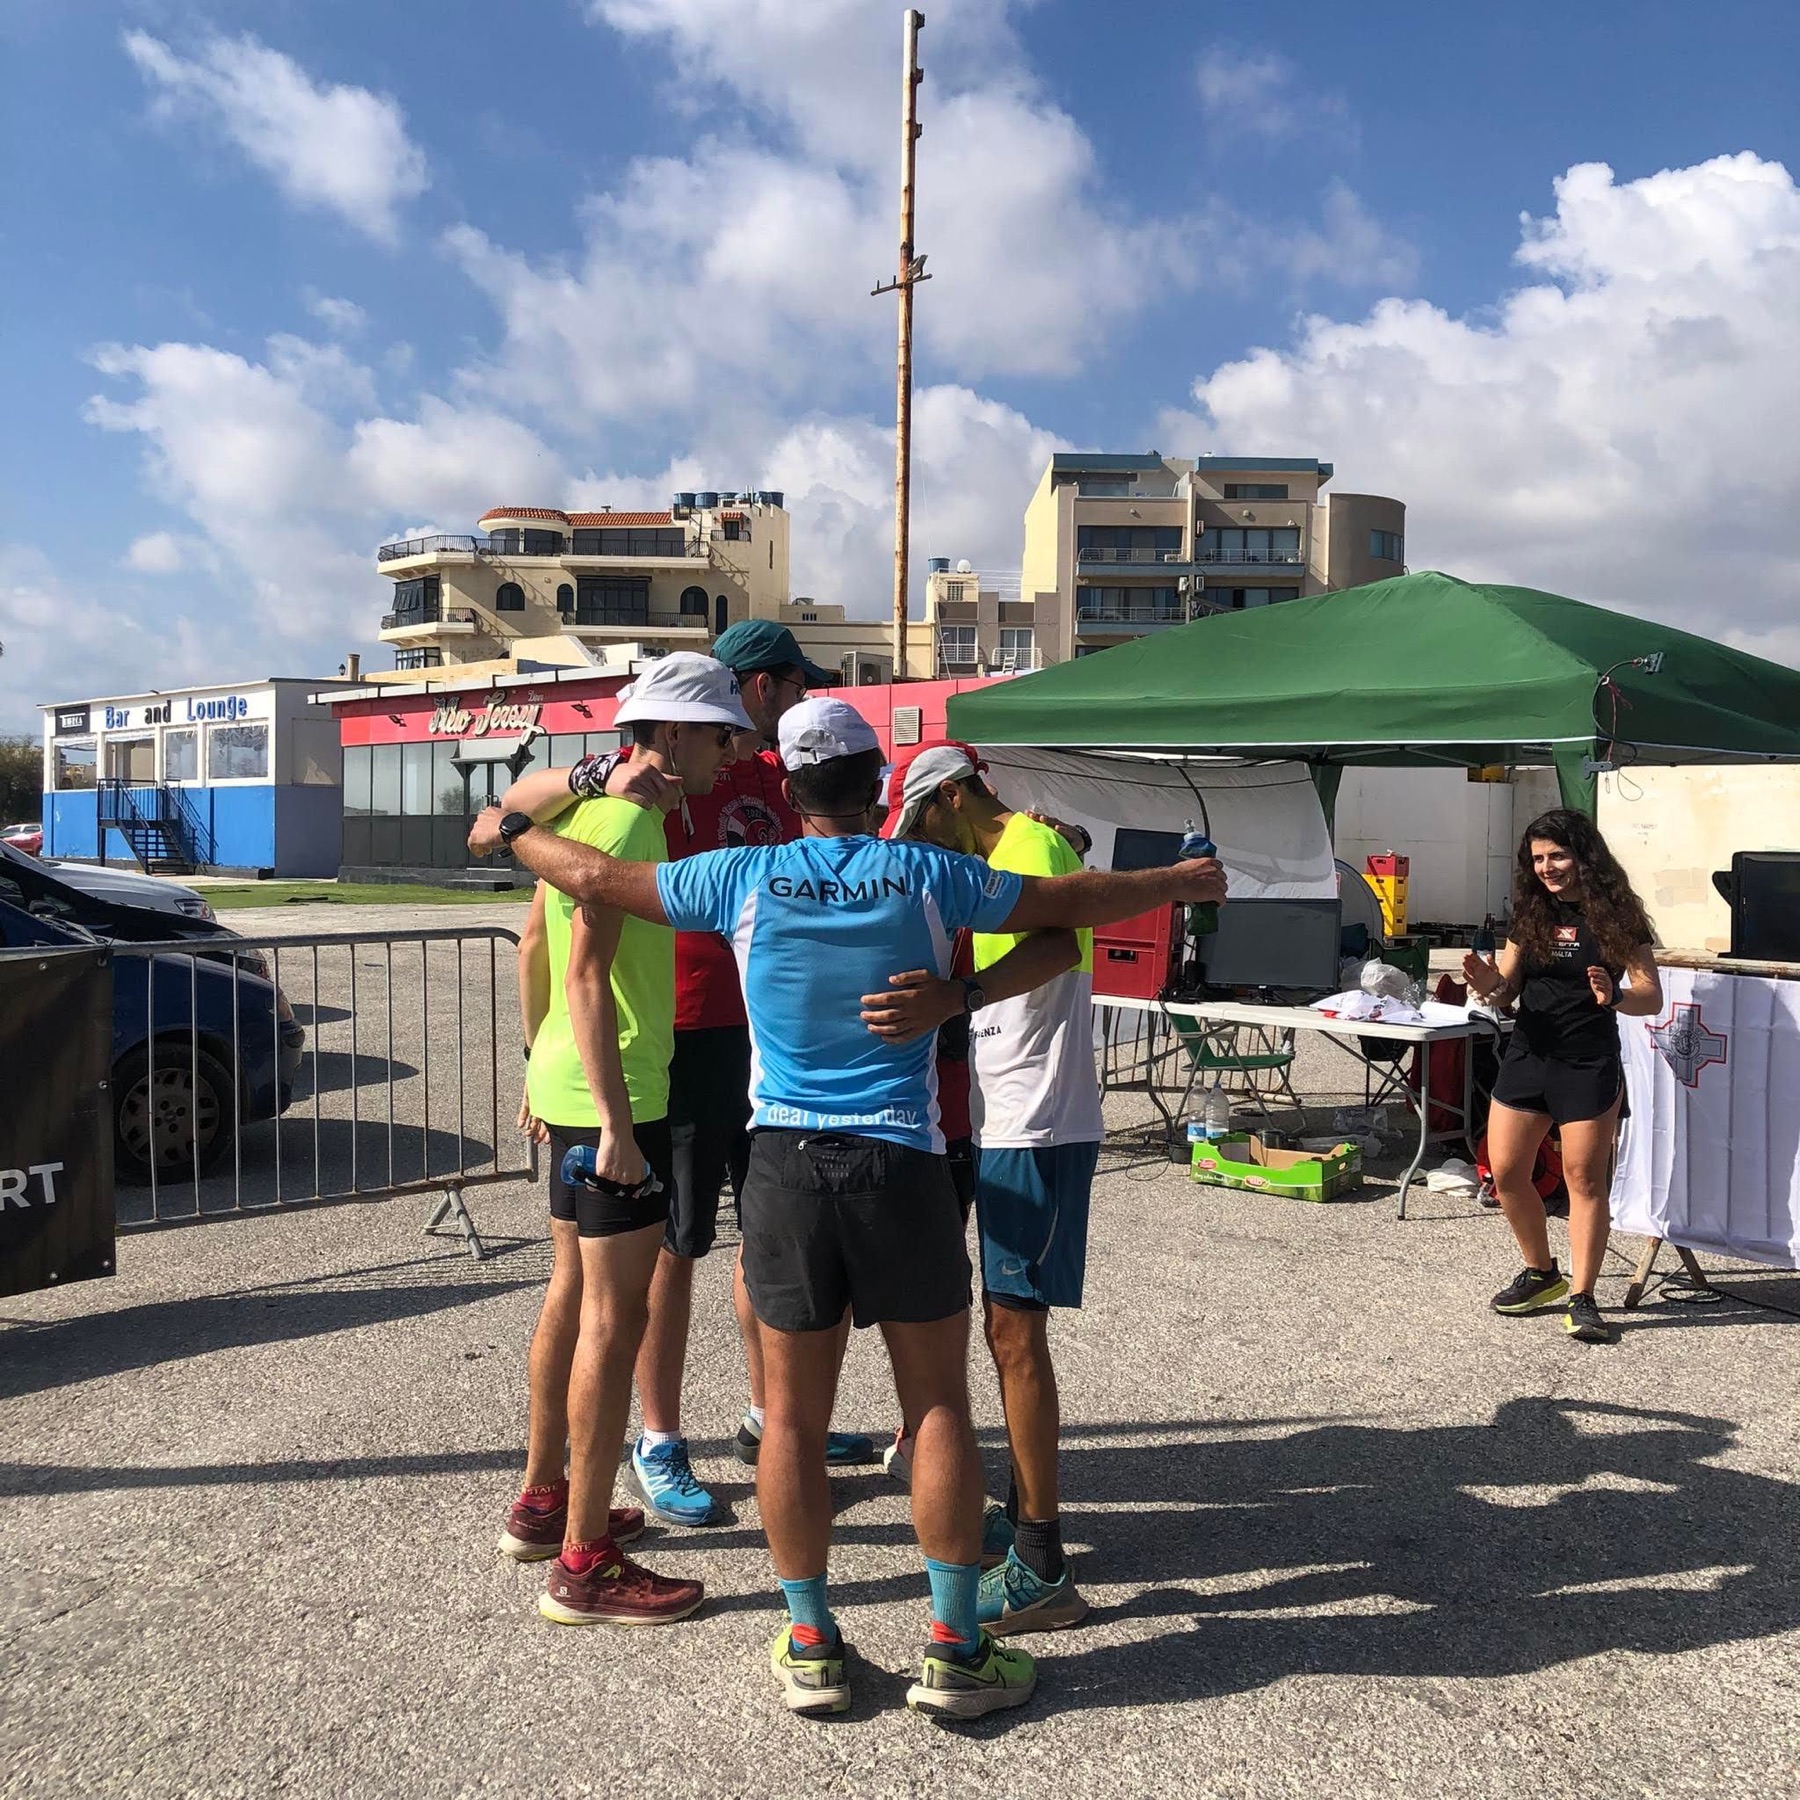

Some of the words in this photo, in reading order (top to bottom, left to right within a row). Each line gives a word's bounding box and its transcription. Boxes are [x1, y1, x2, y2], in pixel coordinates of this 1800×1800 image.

[105, 706, 130, 729] Bar
[144, 700, 172, 724] and
[186, 695, 248, 722] Lounge
[474, 690, 546, 746] Jersey
[768, 876, 907, 906] GARMIN
[817, 1104, 917, 1130] yesterday
